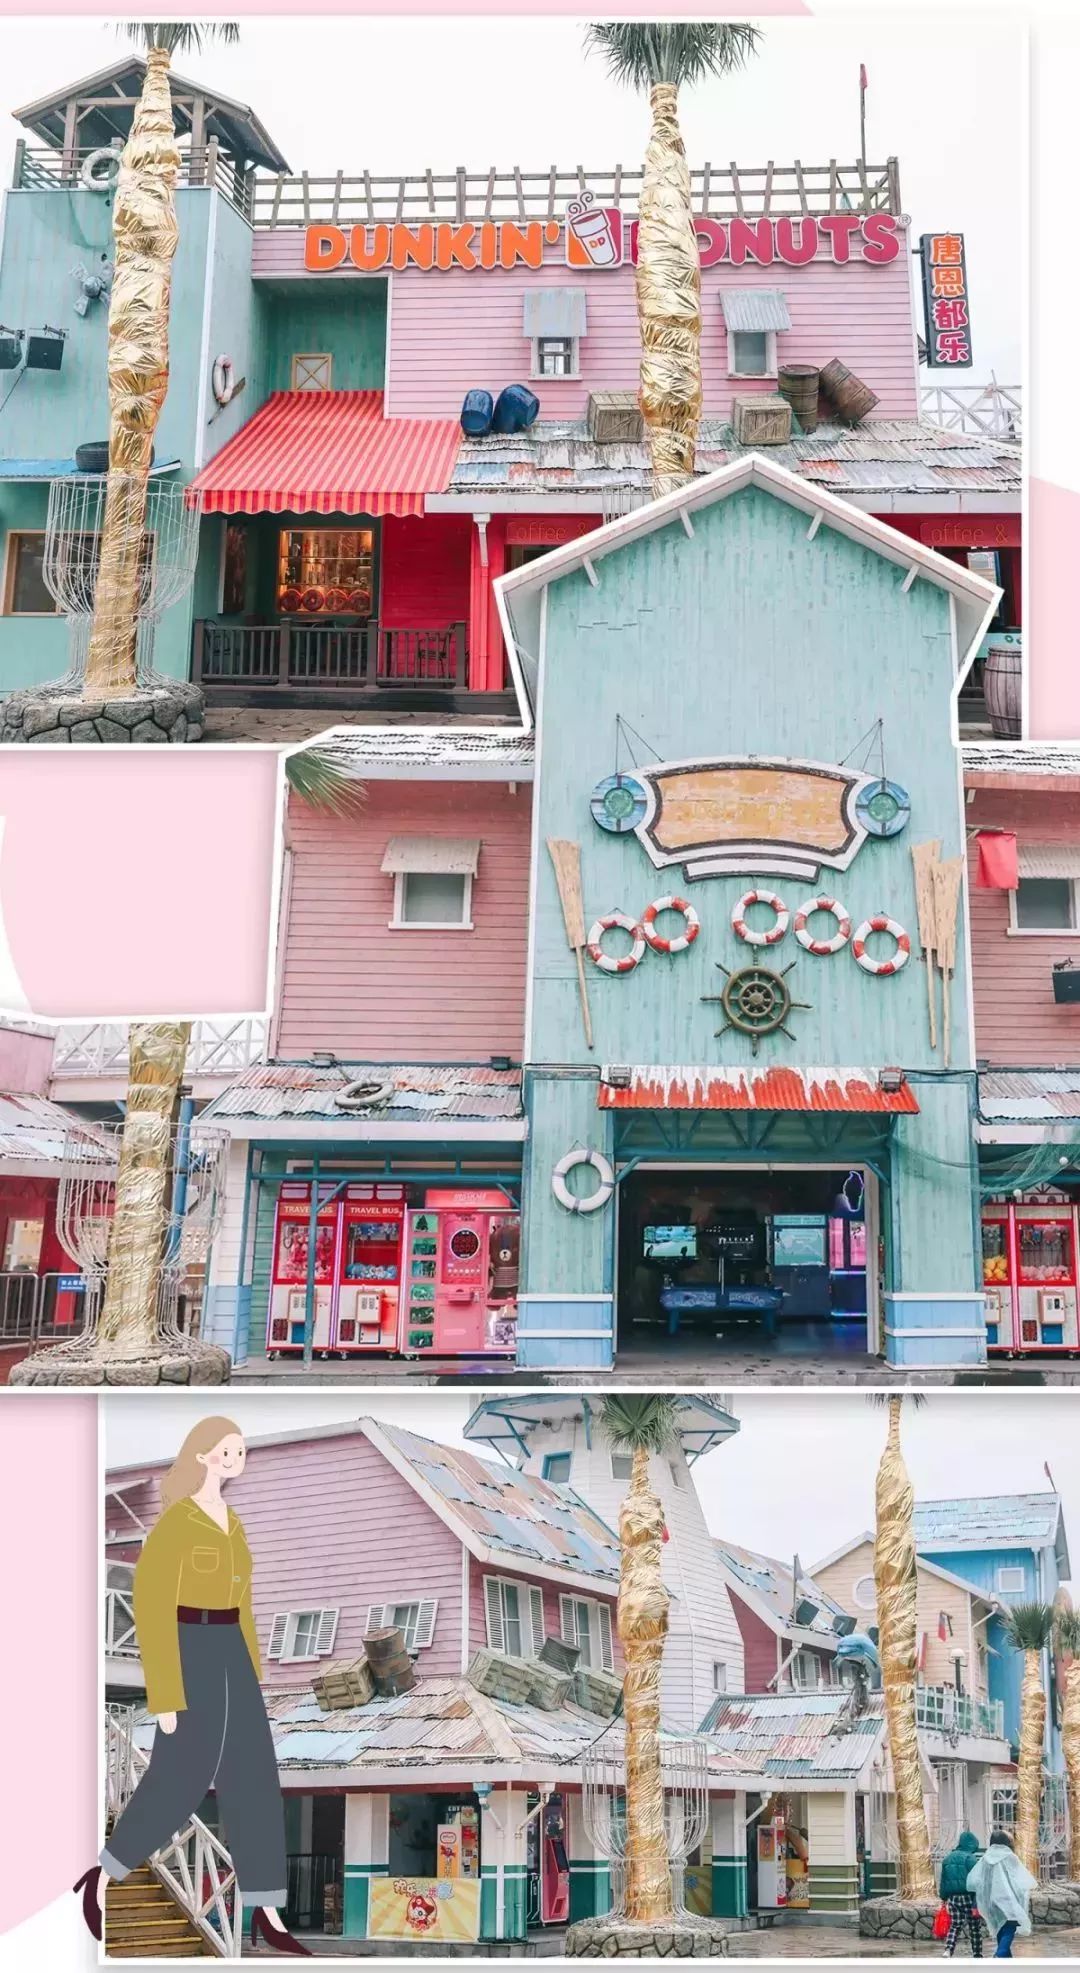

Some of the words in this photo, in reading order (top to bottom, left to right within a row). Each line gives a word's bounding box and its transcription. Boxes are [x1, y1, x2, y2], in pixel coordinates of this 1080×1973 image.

[304, 221, 560, 271] DUNKIN'
[630, 213, 901, 269] ONUTS
[589, 236, 606, 249] DD
[931, 234, 970, 364] 唐恩都乐
[506, 521, 567, 541] Coffee
[920, 522, 985, 542] Coffee
[995, 522, 1009, 543] &
[284, 1205, 311, 1214] TRAVE
[350, 1206, 380, 1215] TRAVEL
[382, 1206, 400, 1215] BUS
